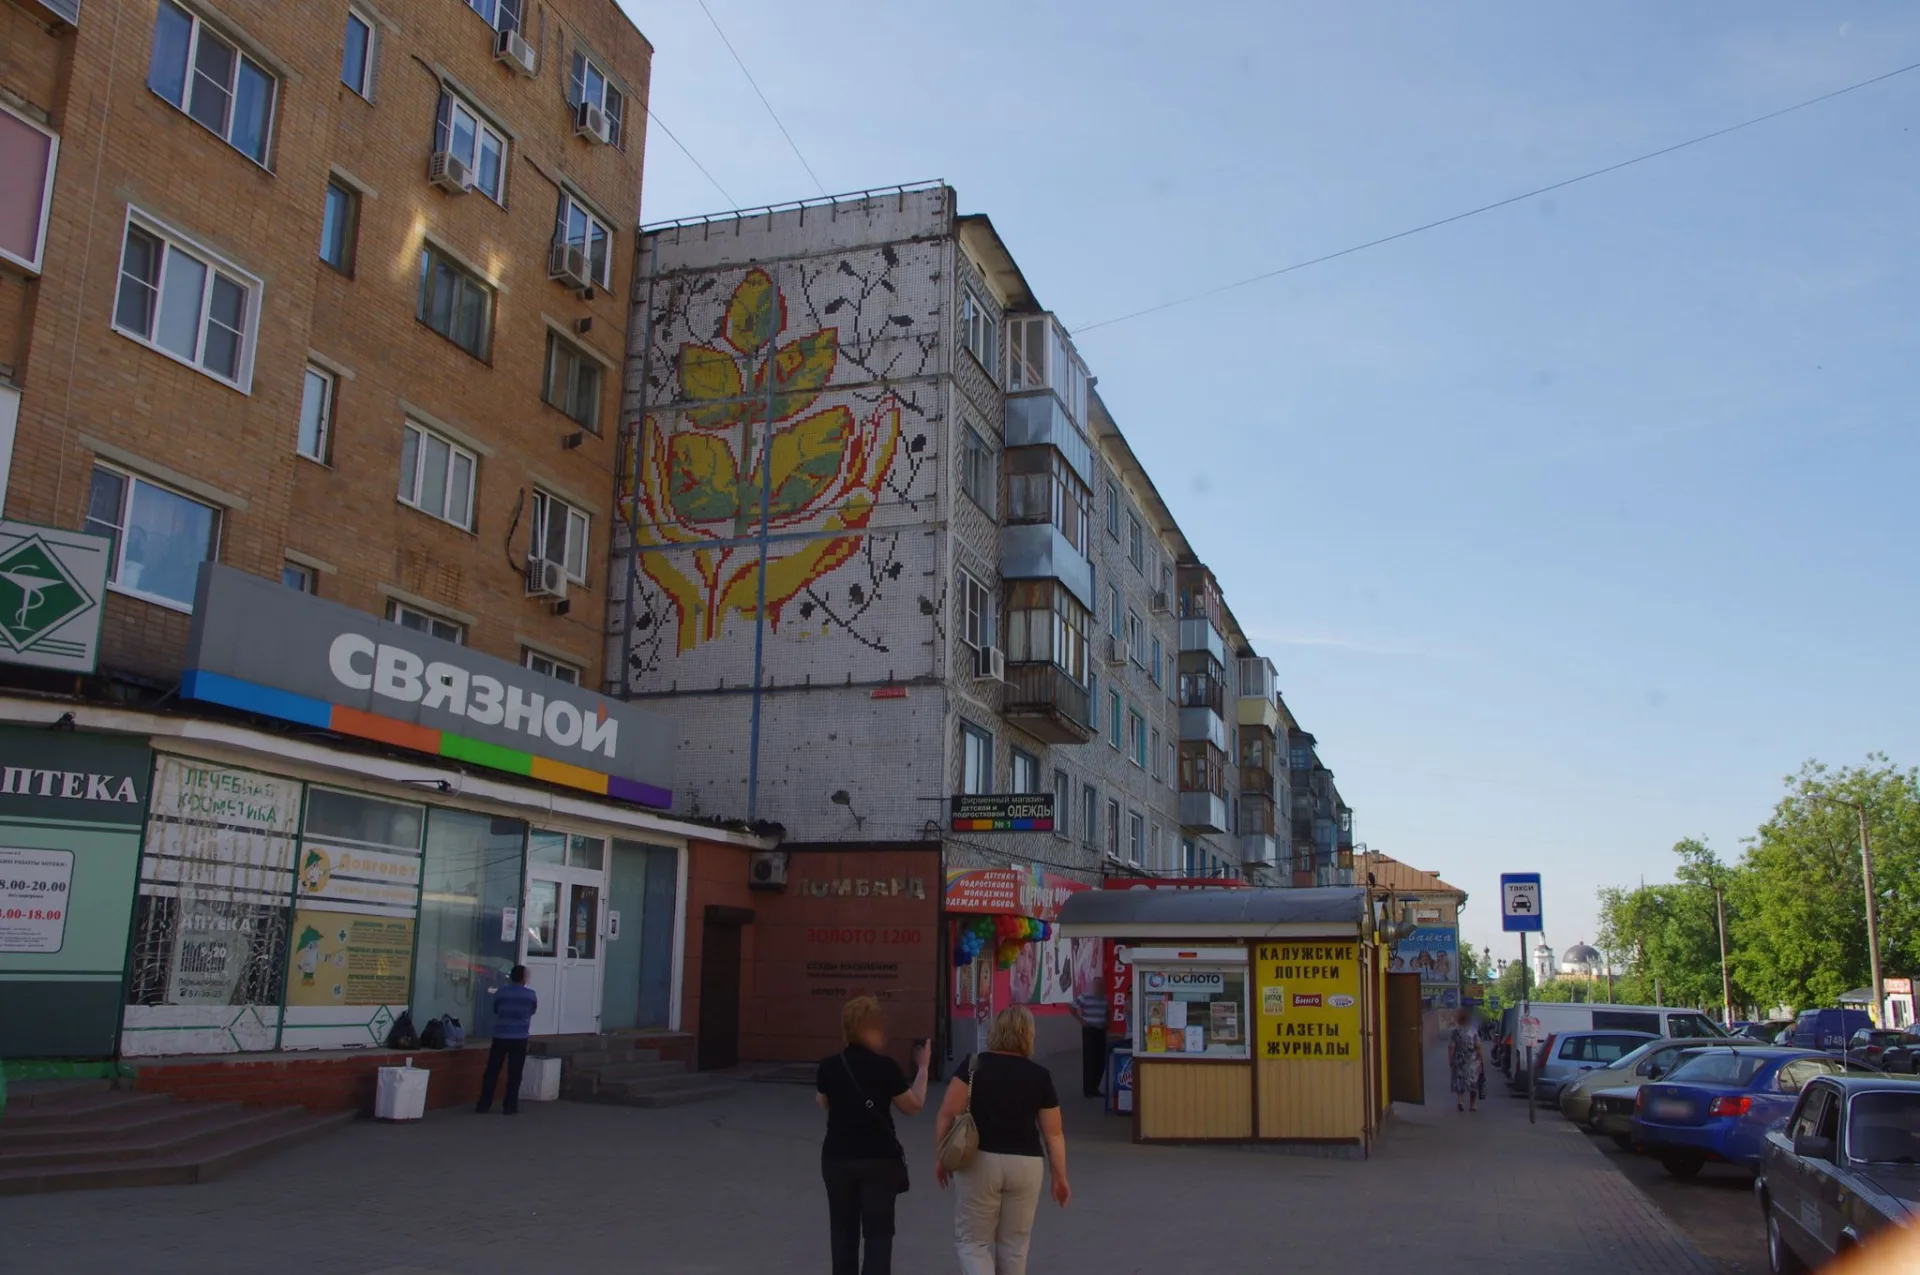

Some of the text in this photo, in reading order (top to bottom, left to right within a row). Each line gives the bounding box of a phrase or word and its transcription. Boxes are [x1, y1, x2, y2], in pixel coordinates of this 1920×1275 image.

[328, 632, 619, 758] СВЯЗНОЙ
[1008, 805, 1053, 818] ОДЕЖДЫ
[984, 872, 1015, 880] ДЕТСКАЯ
[793, 877, 926, 900] ЛОМБАРД
[960, 880, 1014, 889] ПОДРОСТКОВАЯ
[990, 899, 1015, 908] ОБУВЬ
[0, 908, 61, 920] .00-18.00
[807, 929, 876, 945] ЗОЛОТО
[1260, 947, 1352, 960] КАЛУЖСКИЕ
[1168, 974, 1220, 984] ГОСЛОТО
[1274, 966, 1339, 979] ЛОТЕРЕИ
[1295, 996, 1320, 1004] Бинго
[1277, 1023, 1339, 1036] ГАЗЕТЫ
[1267, 1042, 1350, 1055] ЖУРНАЛЫ
